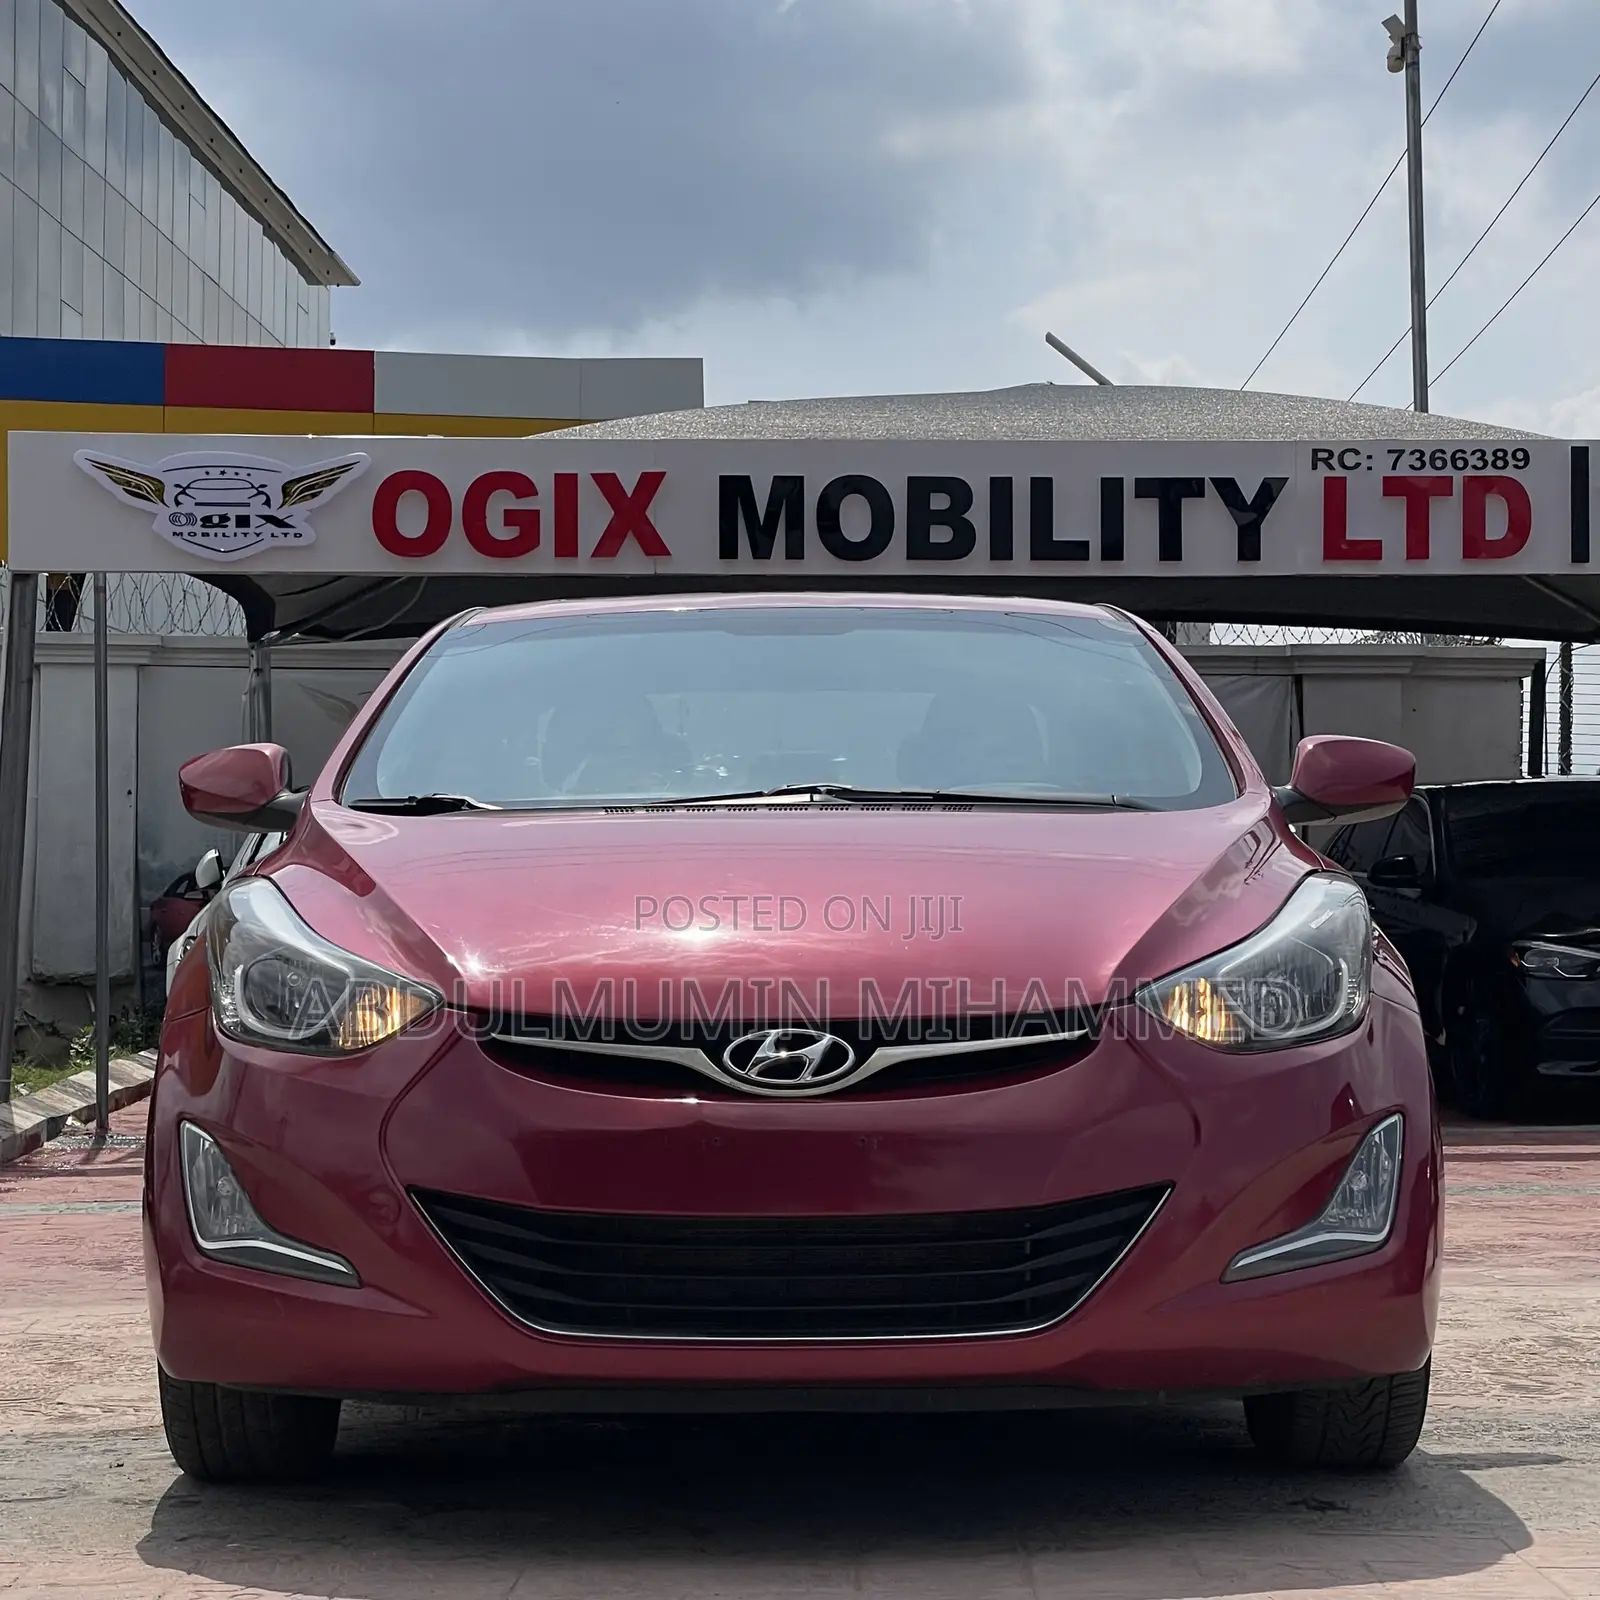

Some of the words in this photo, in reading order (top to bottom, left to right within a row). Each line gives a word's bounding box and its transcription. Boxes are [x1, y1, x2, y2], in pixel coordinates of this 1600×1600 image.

[1311, 448, 1373, 471] RC:
[1387, 447, 1530, 471] 7366389
[371, 470, 671, 559] OGIX
[718, 474, 1289, 562] MOBILITY
[1323, 475, 1532, 560] LTD
